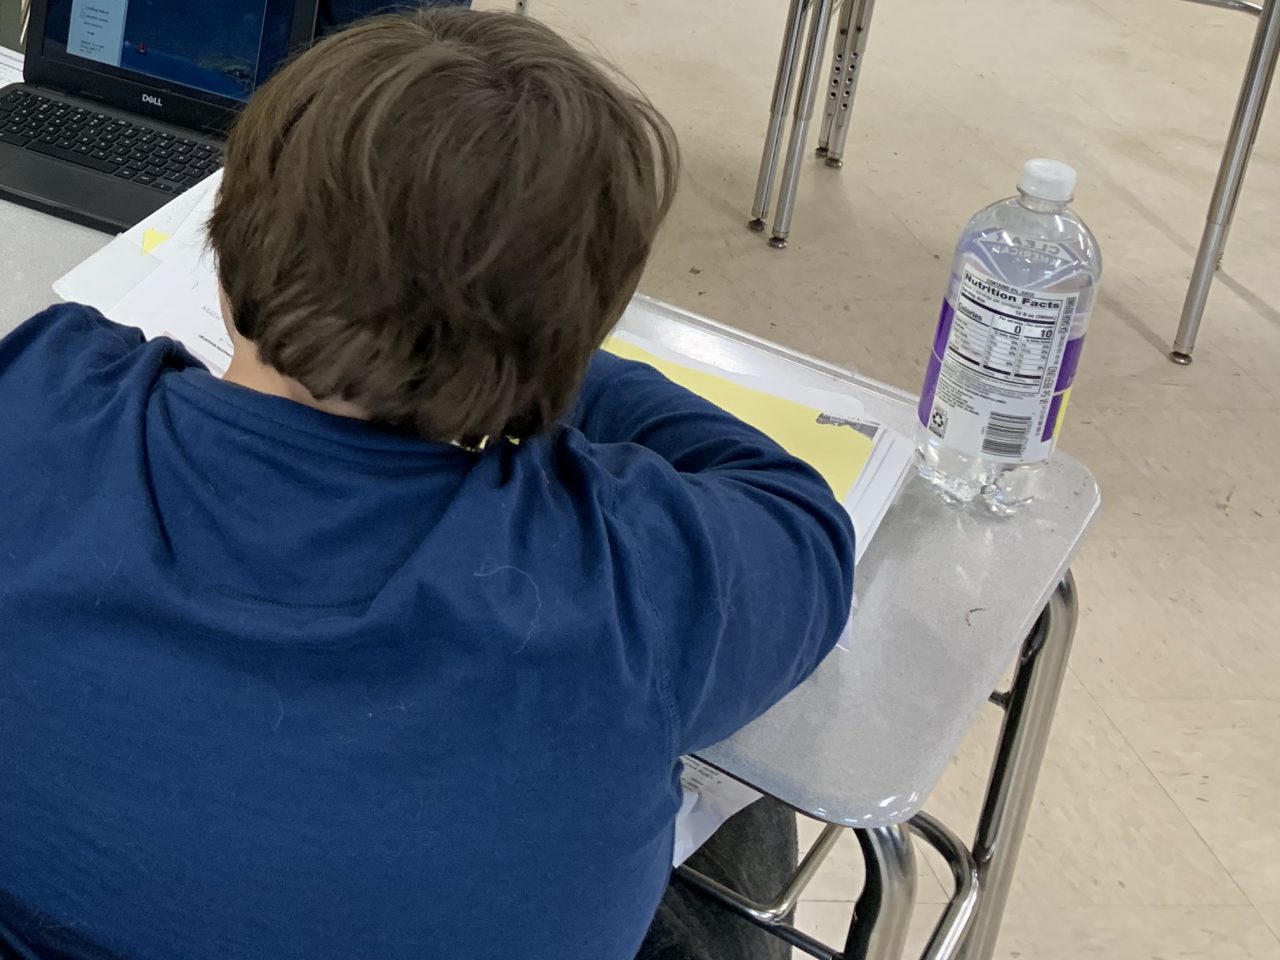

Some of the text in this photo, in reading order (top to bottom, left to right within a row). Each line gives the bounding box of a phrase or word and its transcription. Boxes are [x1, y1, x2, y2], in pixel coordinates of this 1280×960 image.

[142, 93, 163, 107] DELL
[965, 272, 1017, 302] Nutrition
[1022, 298, 1060, 309] Facts
[959, 302, 983, 321] Calories
[1014, 325, 1022, 334] 0
[1041, 329, 1053, 338] 10
